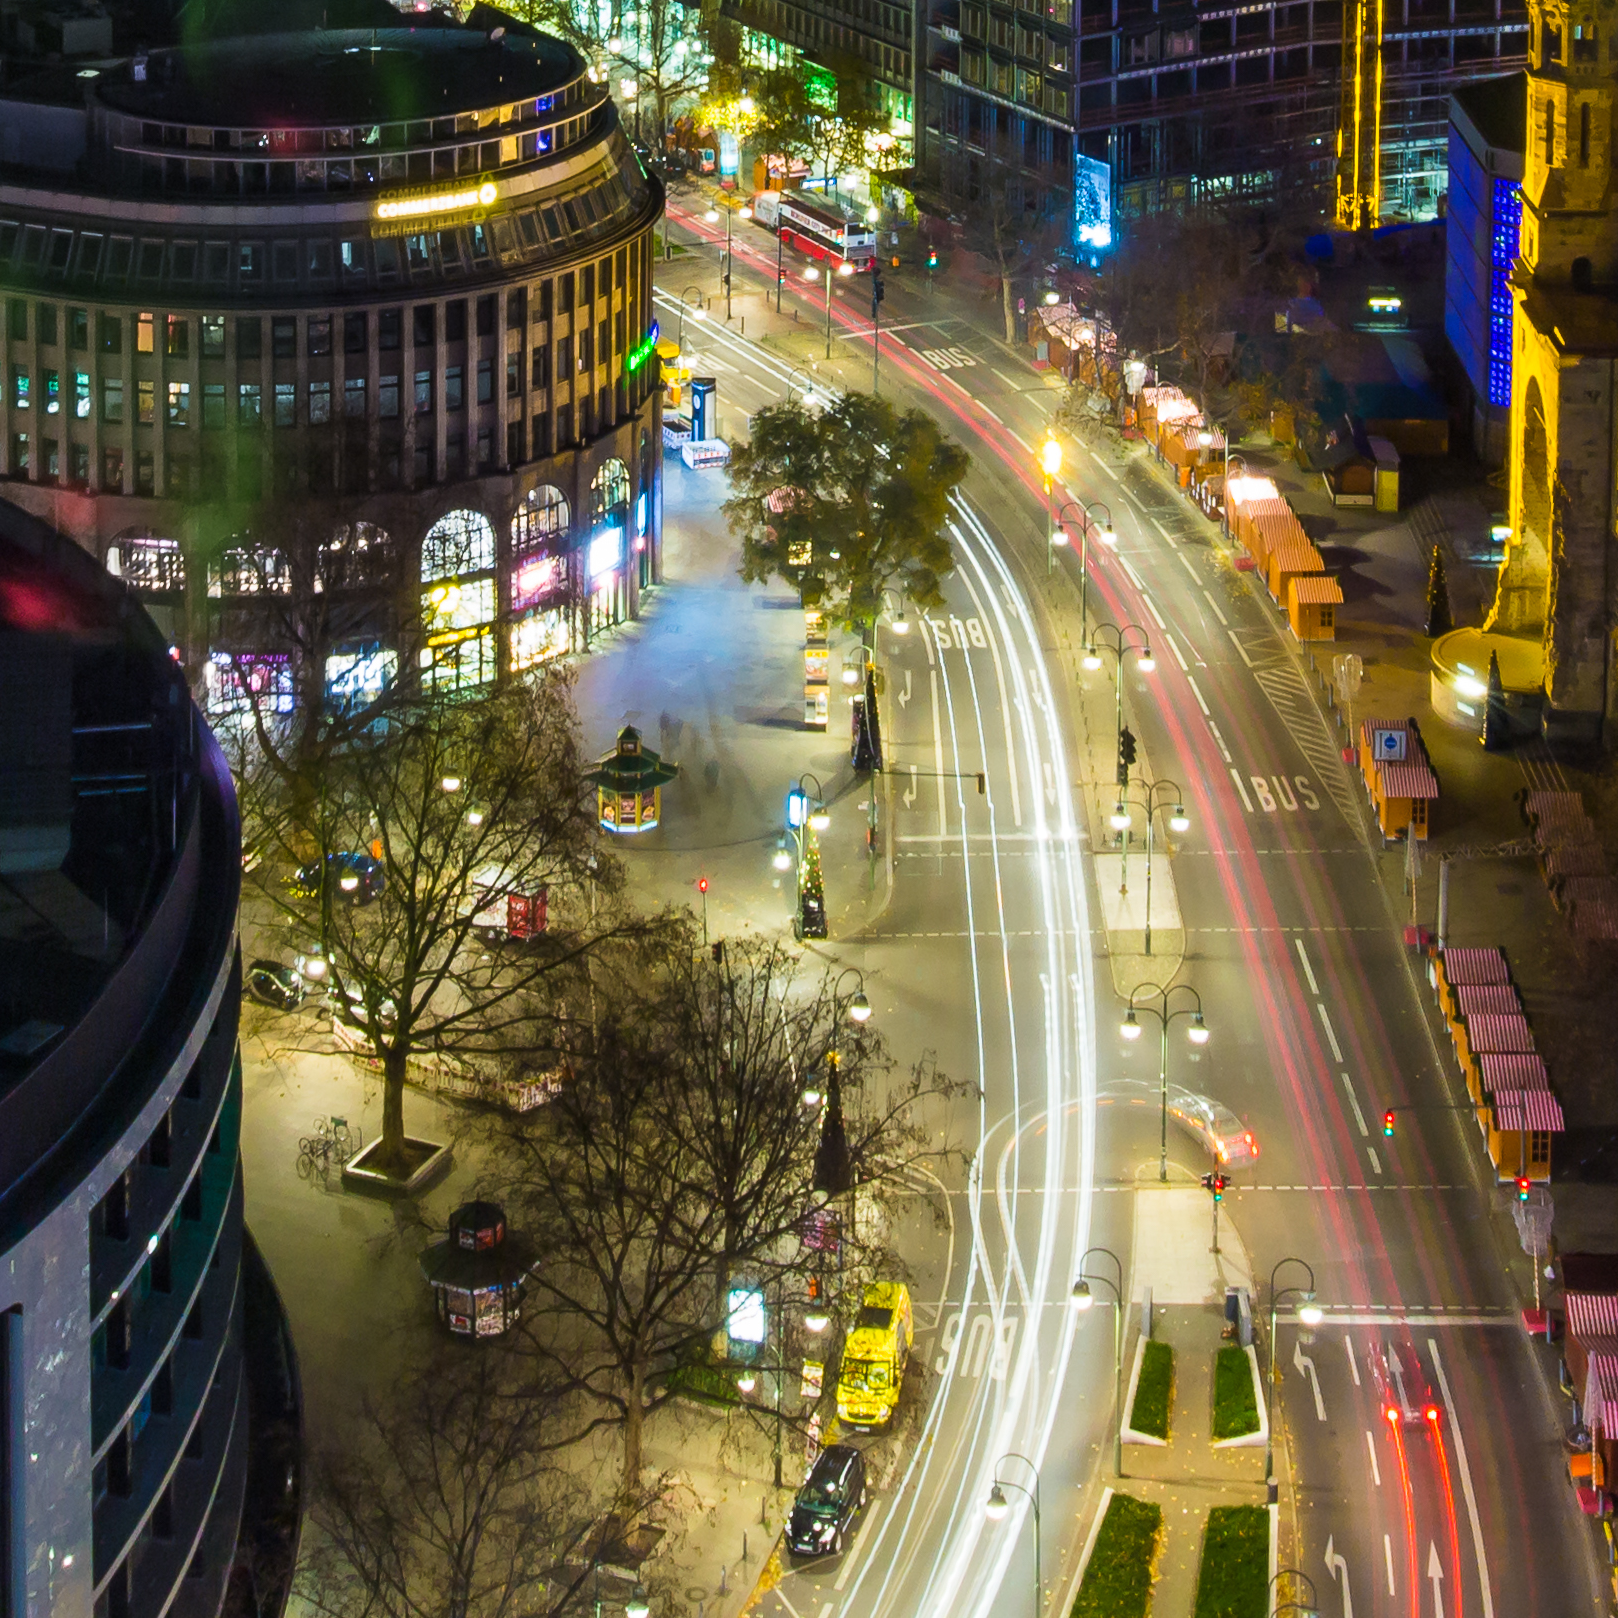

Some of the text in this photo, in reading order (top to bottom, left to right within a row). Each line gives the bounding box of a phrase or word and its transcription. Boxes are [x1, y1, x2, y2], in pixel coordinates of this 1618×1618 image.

[378, 191, 478, 219] COMMERZBANK
[922, 347, 977, 370] BUS
[931, 618, 987, 649] BUS
[1250, 775, 1321, 813] BUS
[934, 1311, 1020, 1381] BUS
